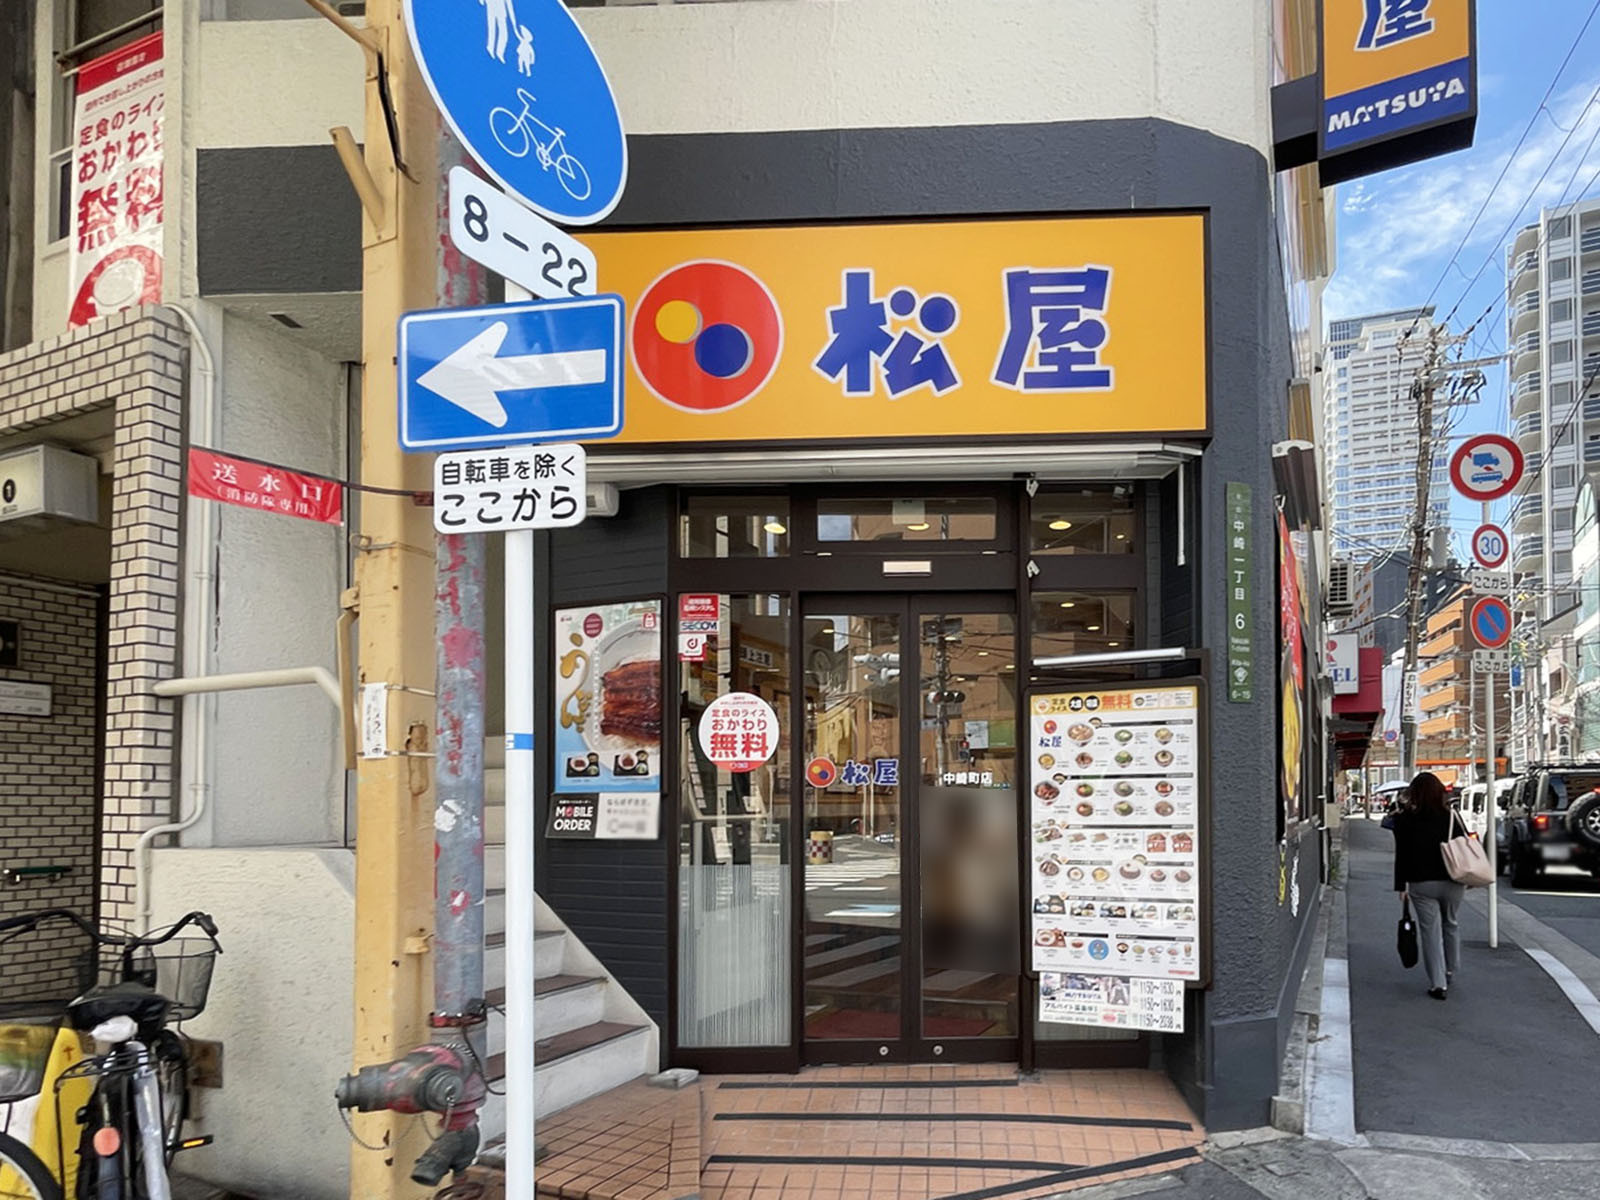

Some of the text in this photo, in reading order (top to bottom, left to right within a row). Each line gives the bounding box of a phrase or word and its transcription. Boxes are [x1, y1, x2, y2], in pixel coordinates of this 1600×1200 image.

[1328, 78, 1465, 133] MATSUYA
[812, 264, 1113, 397] 松屋
[212, 461, 321, 501] 送水口
[441, 453, 577, 485] 自転車を除く
[440, 485, 578, 526] ここから
[1480, 537, 1501, 556] 30
[1474, 576, 1509, 590] ここから
[1235, 613, 1245, 630] 6
[711, 709, 767, 718] 定食のライス
[711, 719, 768, 731] おかわり
[710, 732, 769, 758] 無料
[841, 759, 899, 786] 松屋
[553, 819, 592, 831] ORDER
